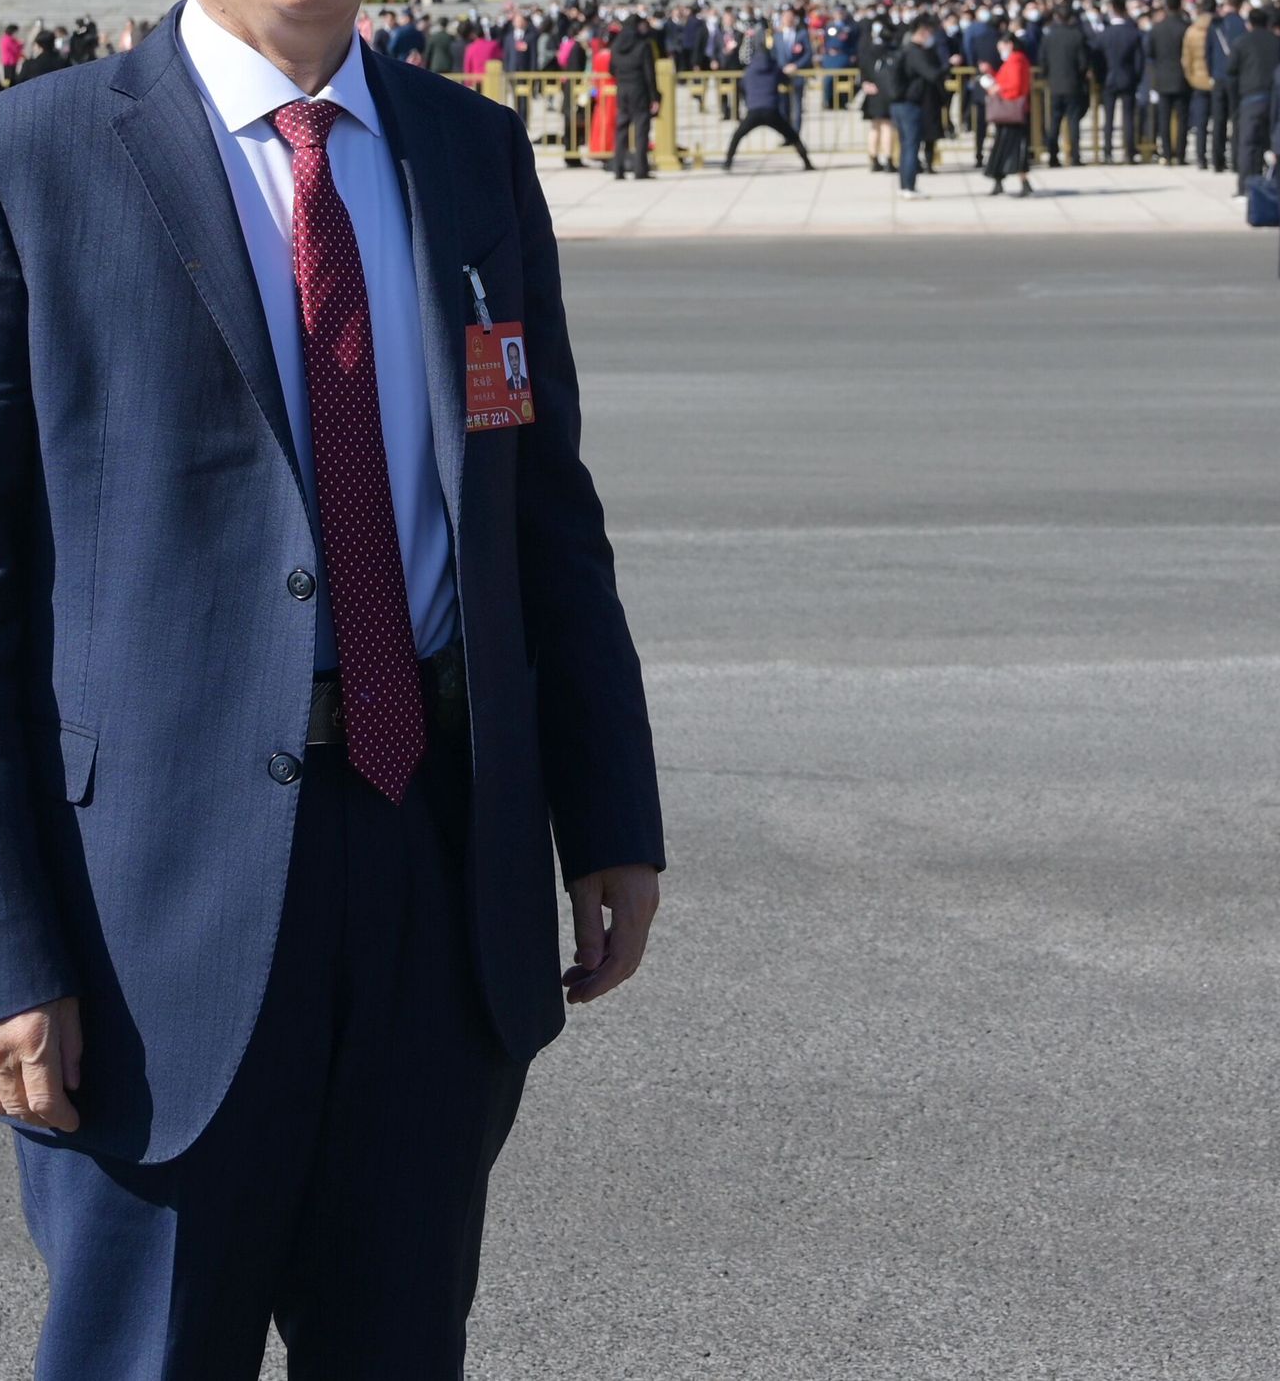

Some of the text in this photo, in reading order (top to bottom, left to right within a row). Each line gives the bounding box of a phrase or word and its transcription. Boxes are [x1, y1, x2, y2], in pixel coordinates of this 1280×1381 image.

[466, 411, 509, 428] 出席证 2214
